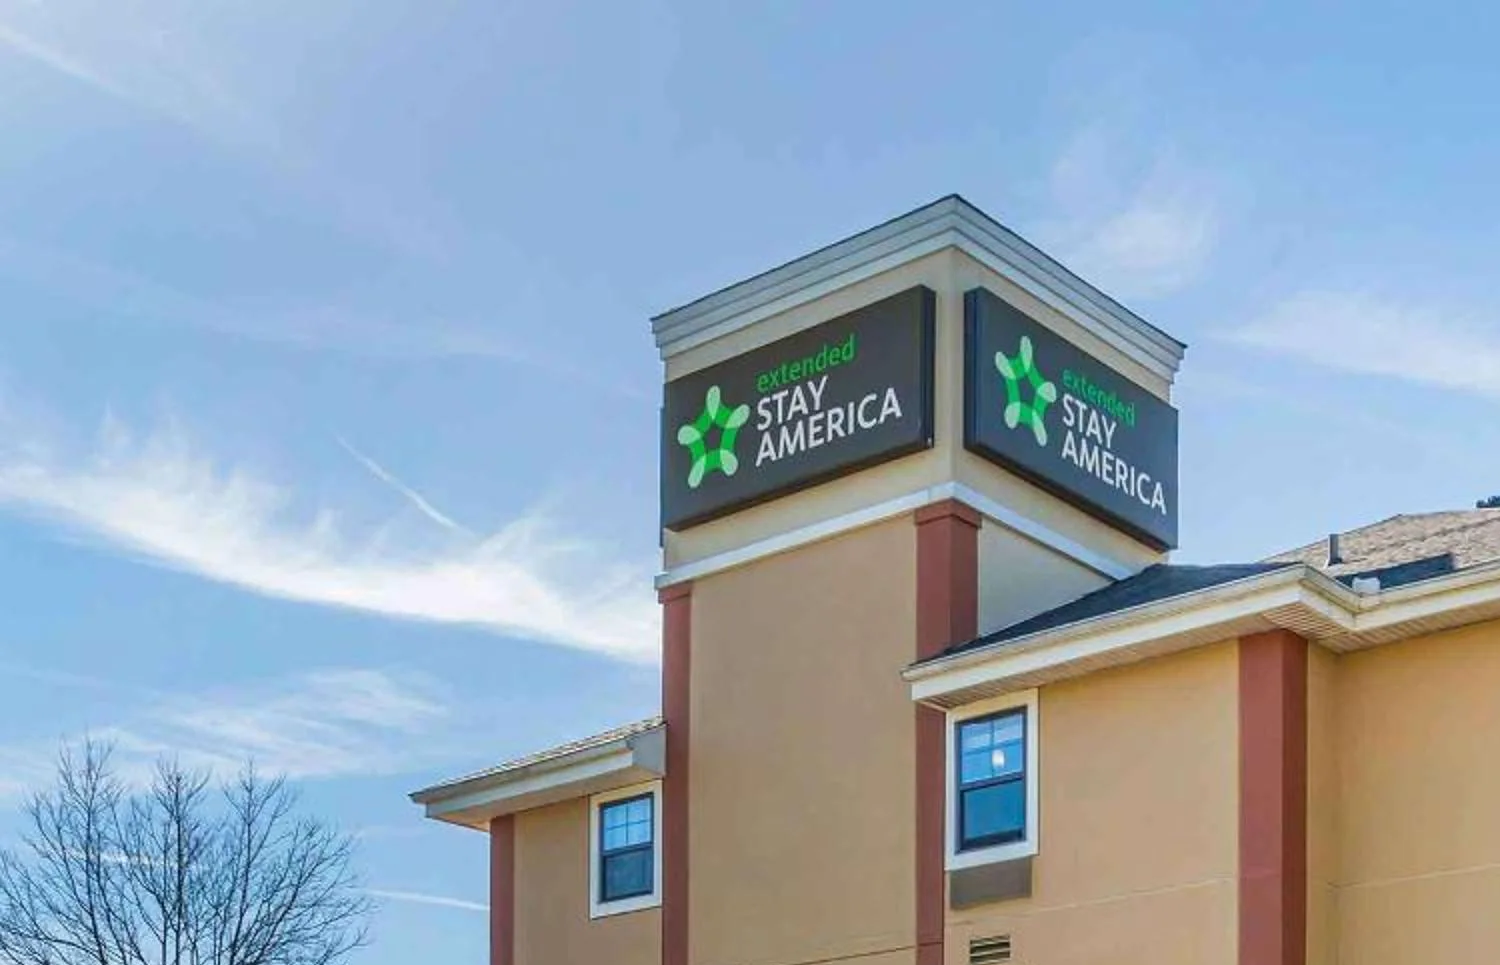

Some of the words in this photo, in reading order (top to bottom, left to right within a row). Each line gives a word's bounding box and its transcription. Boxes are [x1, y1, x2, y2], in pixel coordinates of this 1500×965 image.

[756, 332, 855, 393] extended
[755, 387, 902, 467] AMERICA
[756, 375, 828, 432] STAY
[1063, 368, 1135, 427] extended
[1063, 393, 1117, 449] STAY
[1062, 430, 1167, 515] AMERICA
